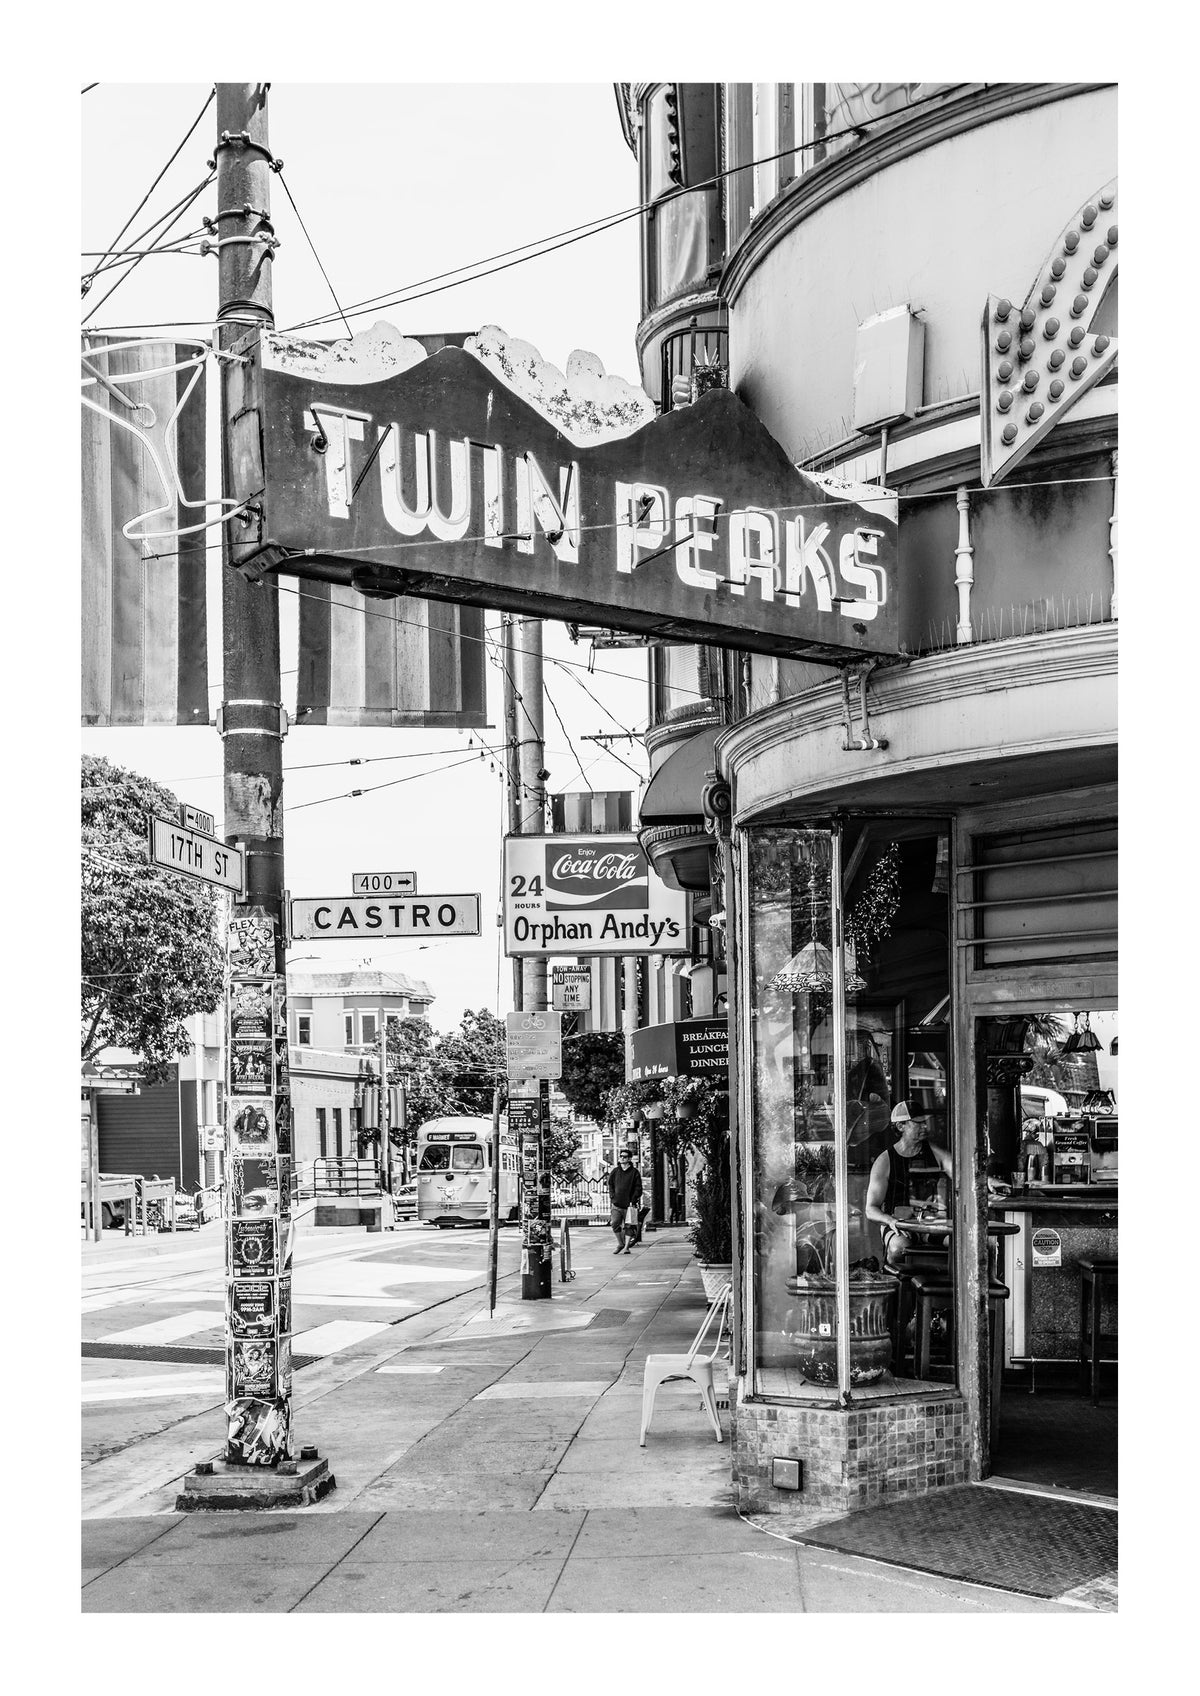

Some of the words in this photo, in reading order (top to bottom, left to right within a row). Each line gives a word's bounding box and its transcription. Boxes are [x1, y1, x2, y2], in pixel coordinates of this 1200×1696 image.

[304, 403, 581, 564] TWIN
[615, 481, 887, 621] PEAKS
[194, 812, 211, 833] 4000
[171, 833, 203, 869] 17TH
[214, 851, 229, 878] ST
[577, 848, 597, 857] Enjoy
[552, 853, 640, 880] Coca-Cola
[360, 875, 393, 891] 400
[510, 875, 544, 897] 24
[229, 918, 255, 932] FLEX
[314, 903, 457, 930] CASTRO
[513, 914, 593, 948] Orphan
[599, 913, 681, 947] Andy's
[553, 973, 564, 984] NO
[564, 974, 590, 984] STOPPING
[564, 985, 579, 993] ANY
[563, 993, 580, 1002] TIME
